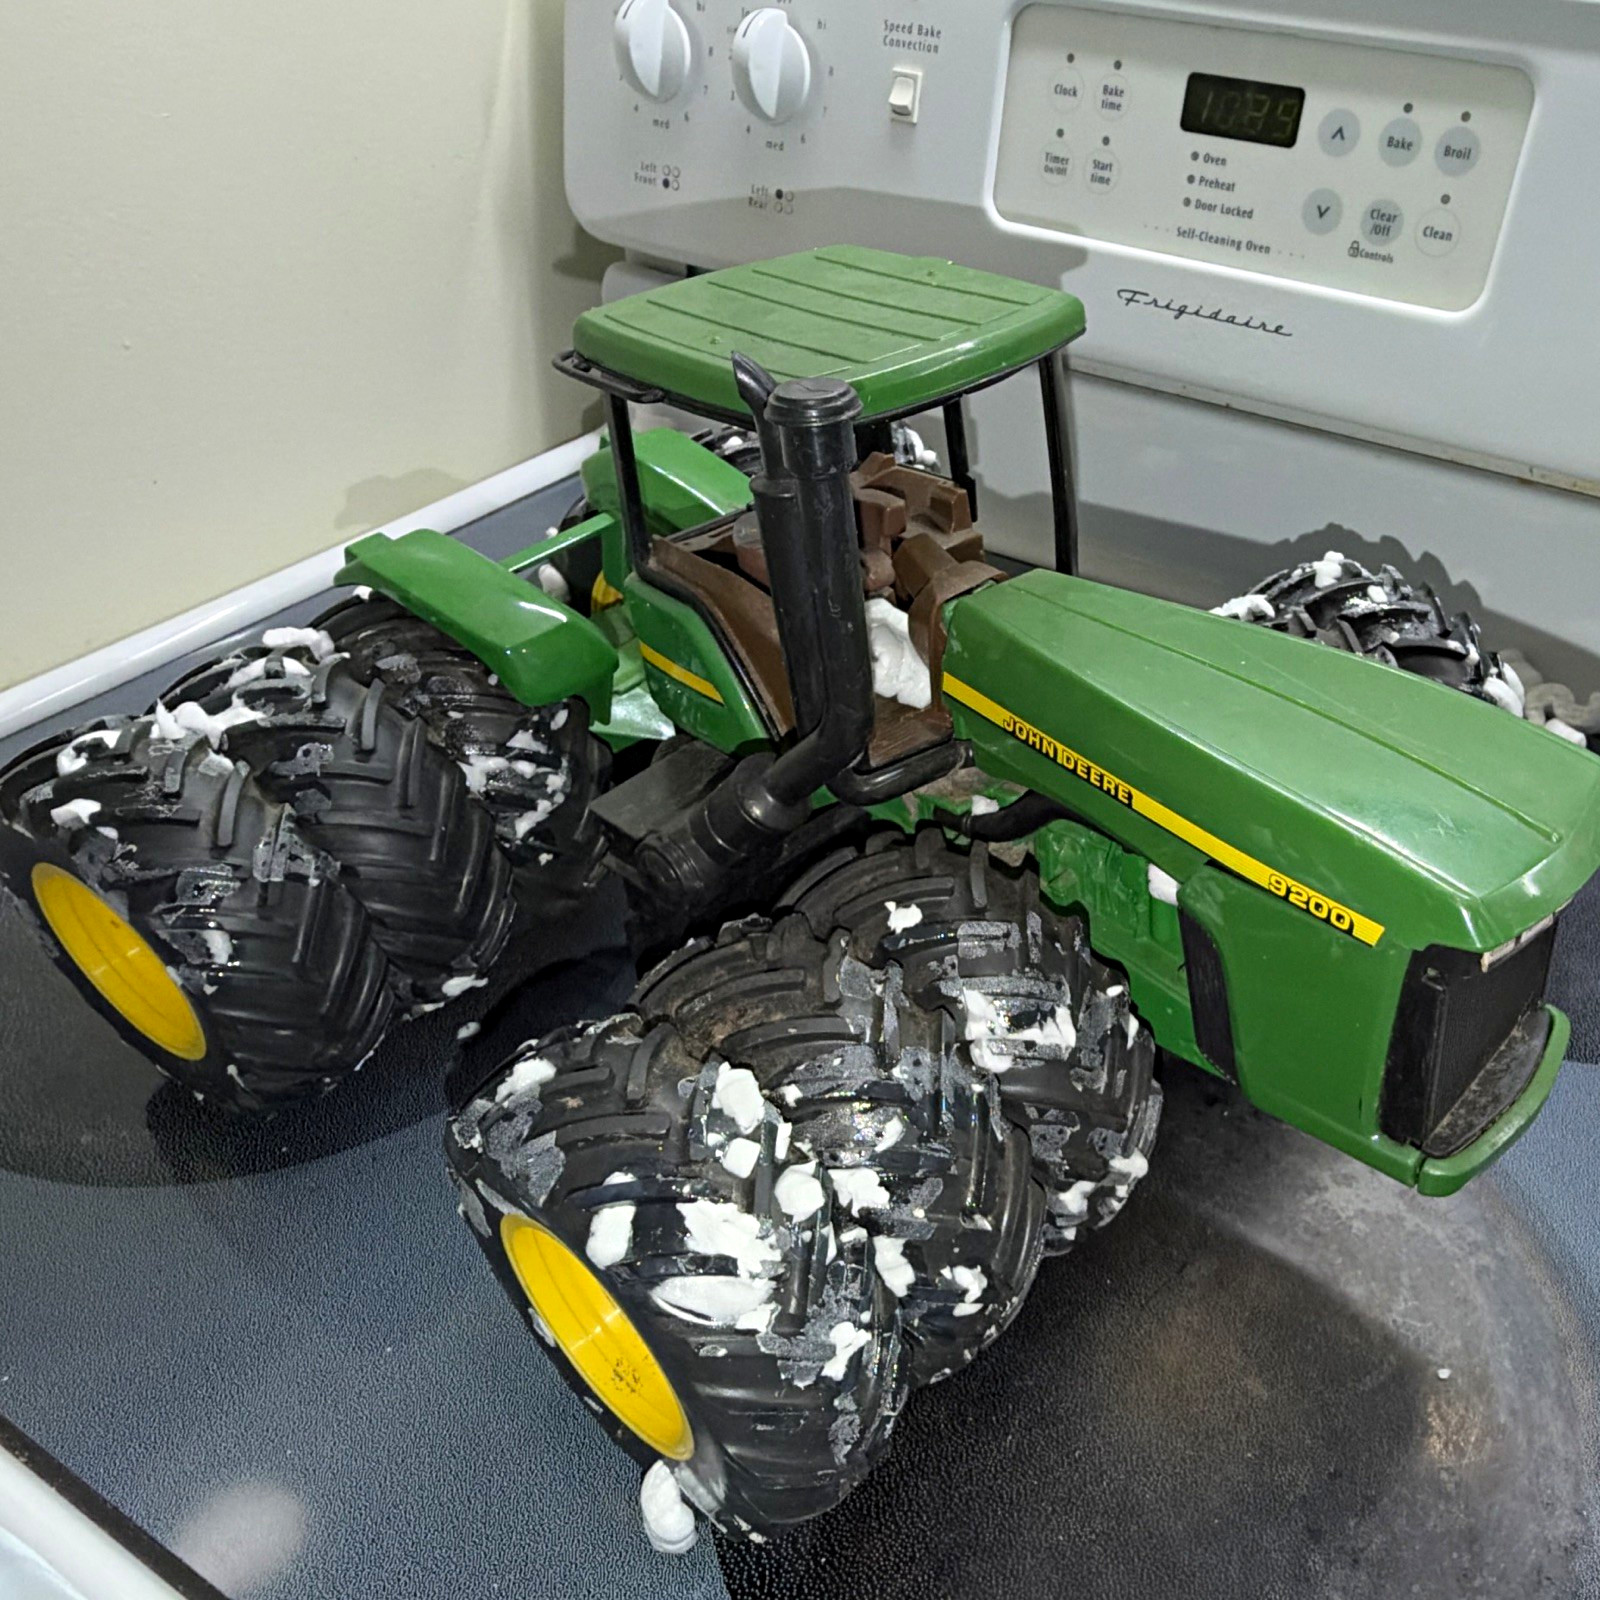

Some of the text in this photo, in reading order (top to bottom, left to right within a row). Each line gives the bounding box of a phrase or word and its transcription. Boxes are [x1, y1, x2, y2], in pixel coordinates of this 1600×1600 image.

[883, 19, 943, 39] Speed Bake
[882, 35, 940, 54] Convection
[1054, 83, 1078, 98] Clock
[1102, 84, 1125, 98] Bake
[1101, 99, 1123, 112] time
[652, 118, 671, 130] med
[765, 140, 785, 151] med
[1386, 136, 1414, 152] Bake
[1044, 151, 1070, 166] Timer
[1203, 153, 1227, 167] Oven
[1443, 145, 1472, 161] Broil
[640, 161, 658, 174] Left
[1092, 158, 1113, 173] Start
[633, 172, 658, 187] Front
[1090, 171, 1111, 186] time
[1198, 175, 1236, 193] Preheat
[751, 184, 770, 199] Left
[748, 196, 769, 210] Rear
[1194, 198, 1254, 220] Door Locked
[1370, 209, 1397, 223] Clear
[1369, 223, 1392, 237] /Off
[1422, 225, 1453, 242] Clean
[1176, 226, 1271, 255] Self-Cleaning Oven
[1358, 248, 1394, 264] Controls
[1117, 289, 1293, 337] Frigidaire
[1003, 714, 1132, 804] JOHN DEERE
[1267, 872, 1353, 933] 9200
